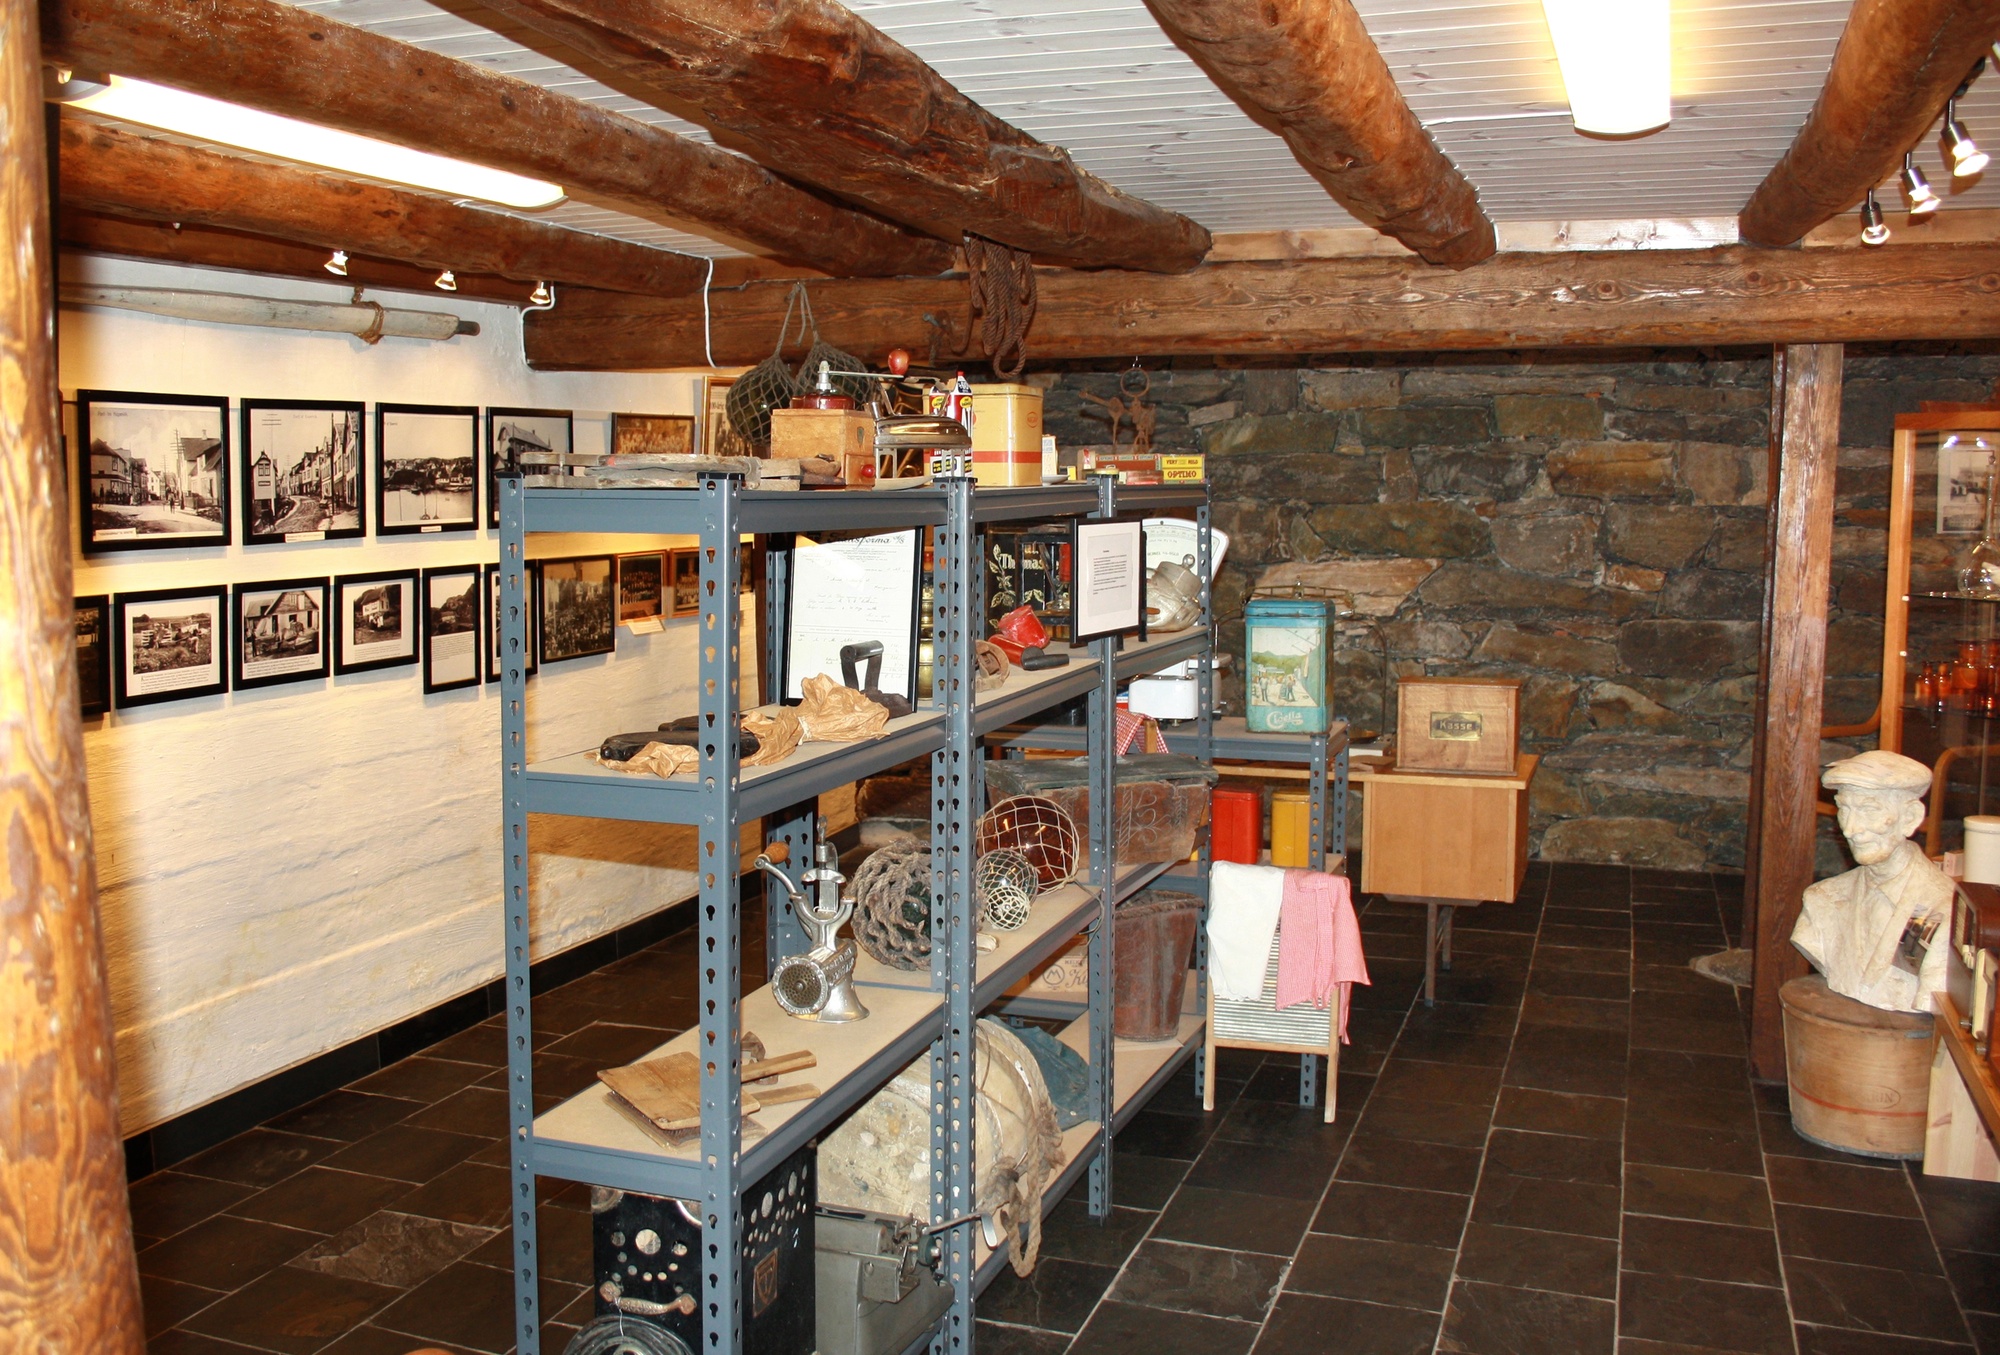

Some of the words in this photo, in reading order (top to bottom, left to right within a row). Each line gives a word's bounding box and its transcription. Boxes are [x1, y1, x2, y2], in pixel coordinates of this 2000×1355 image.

[1167, 470, 1197, 479] OPTIMO
[1000, 553, 1045, 570] Thmas
[1439, 720, 1473, 731] Kasse
